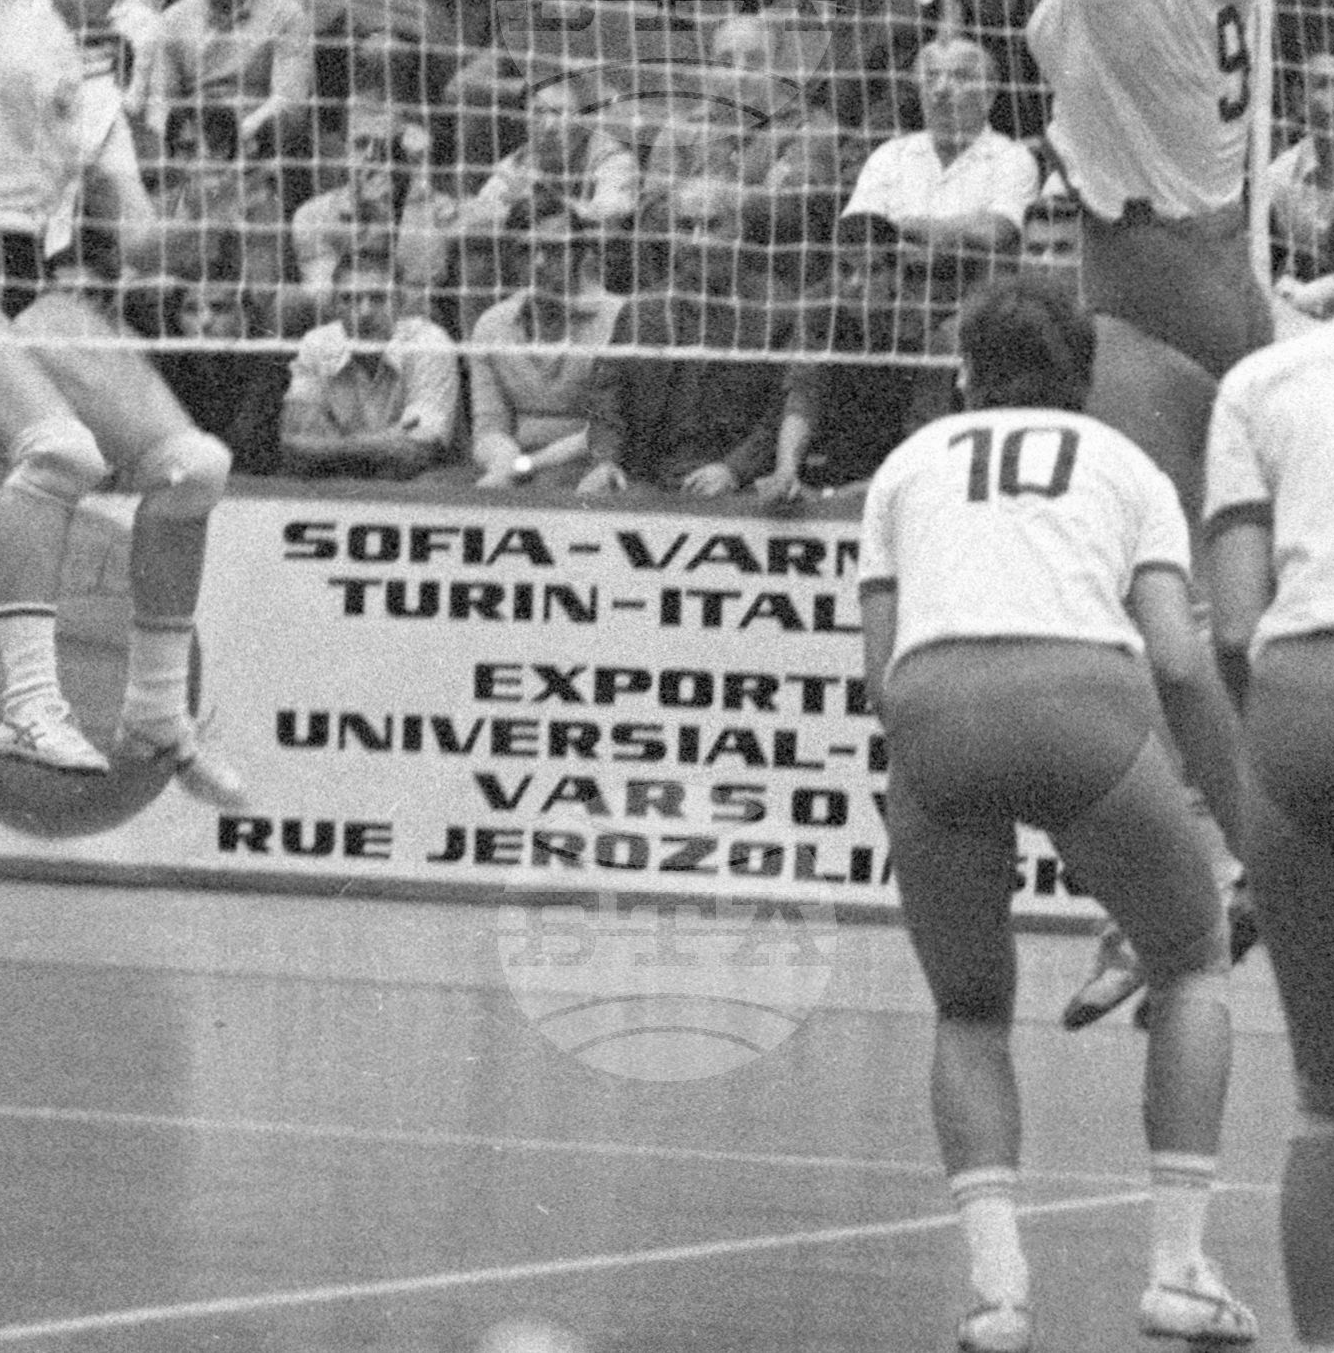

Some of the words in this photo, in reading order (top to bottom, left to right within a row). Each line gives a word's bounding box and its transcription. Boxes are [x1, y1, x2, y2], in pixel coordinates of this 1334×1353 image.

[1218, 4, 1251, 123] 9
[948, 426, 1080, 501] 10
[473, 771, 885, 830] VARSO
[216, 811, 394, 861] RUE
[425, 824, 891, 886] JEROZOLI
